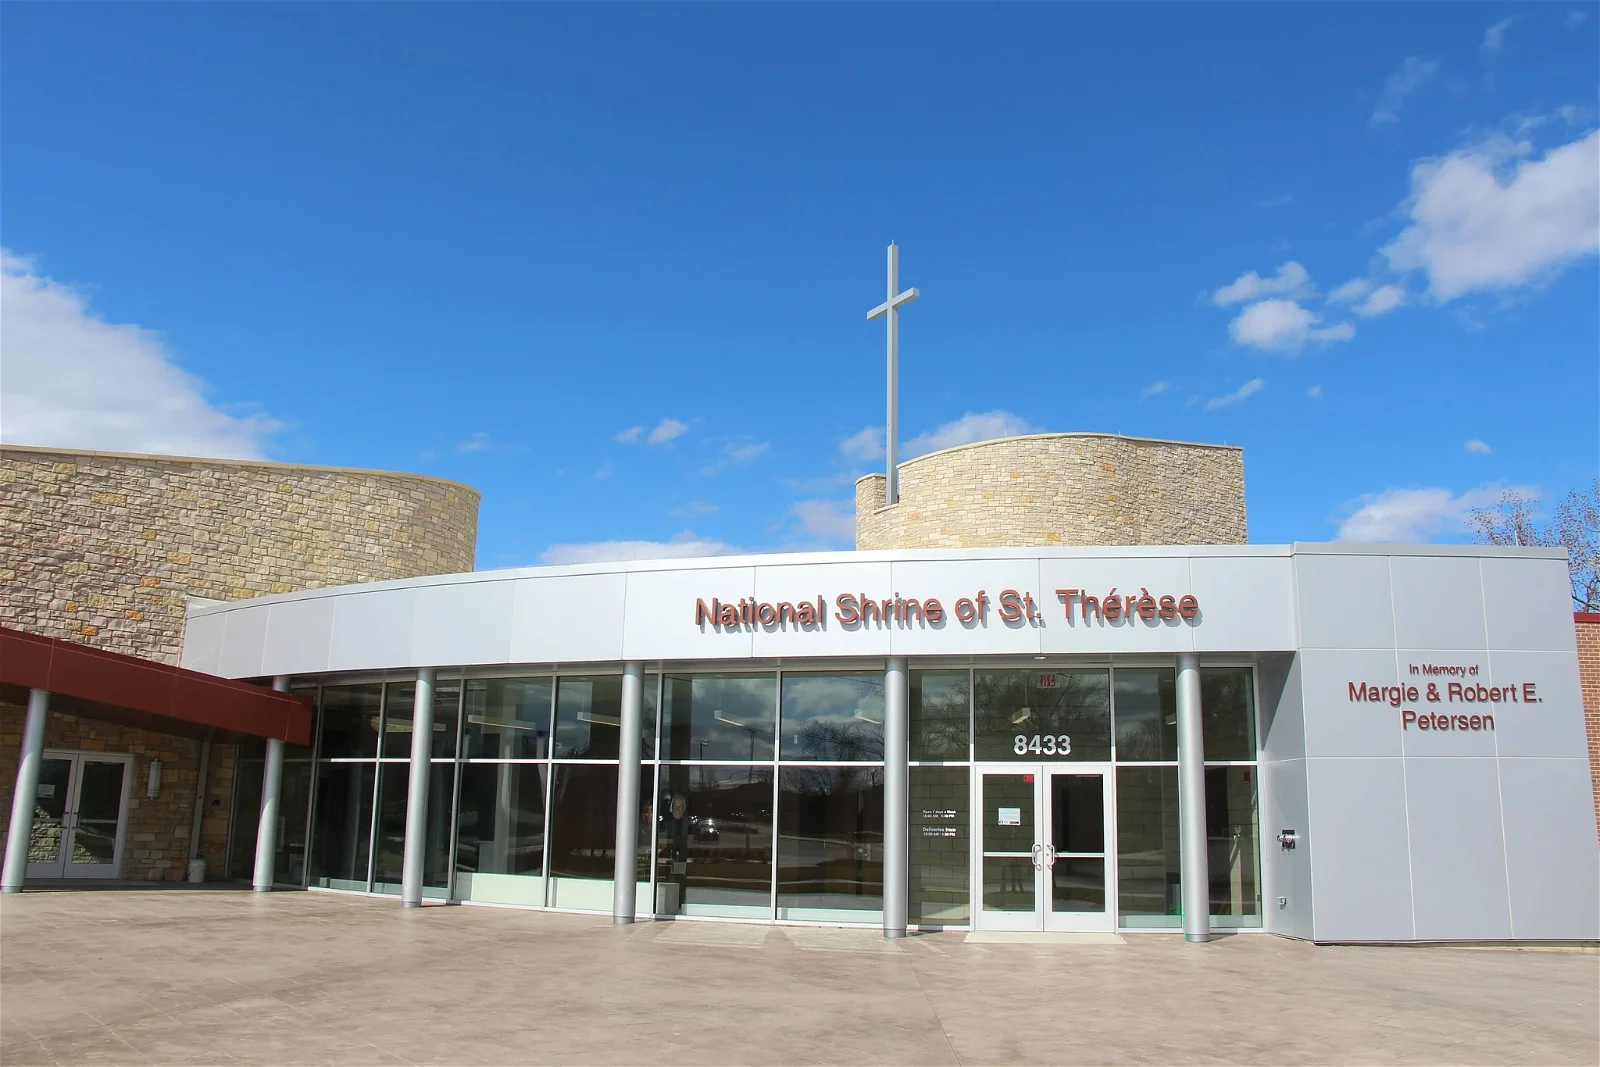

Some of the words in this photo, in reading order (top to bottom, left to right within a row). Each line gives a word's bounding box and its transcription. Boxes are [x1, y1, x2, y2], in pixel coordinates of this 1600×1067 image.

[694, 594, 824, 626] National
[834, 592, 943, 624] Shrine
[954, 590, 987, 621] of
[998, 589, 1042, 621] St.
[1055, 587, 1199, 620] Thérèse
[1409, 664, 1420, 675] In
[1422, 664, 1466, 678] Memory
[1468, 664, 1480, 676] of
[1348, 681, 1420, 707] Margie
[1426, 682, 1442, 703] &
[1447, 682, 1519, 703] Robert
[1522, 683, 1543, 703] E.
[1402, 710, 1496, 731] Petersen
[1013, 734, 1072, 755] 8433
